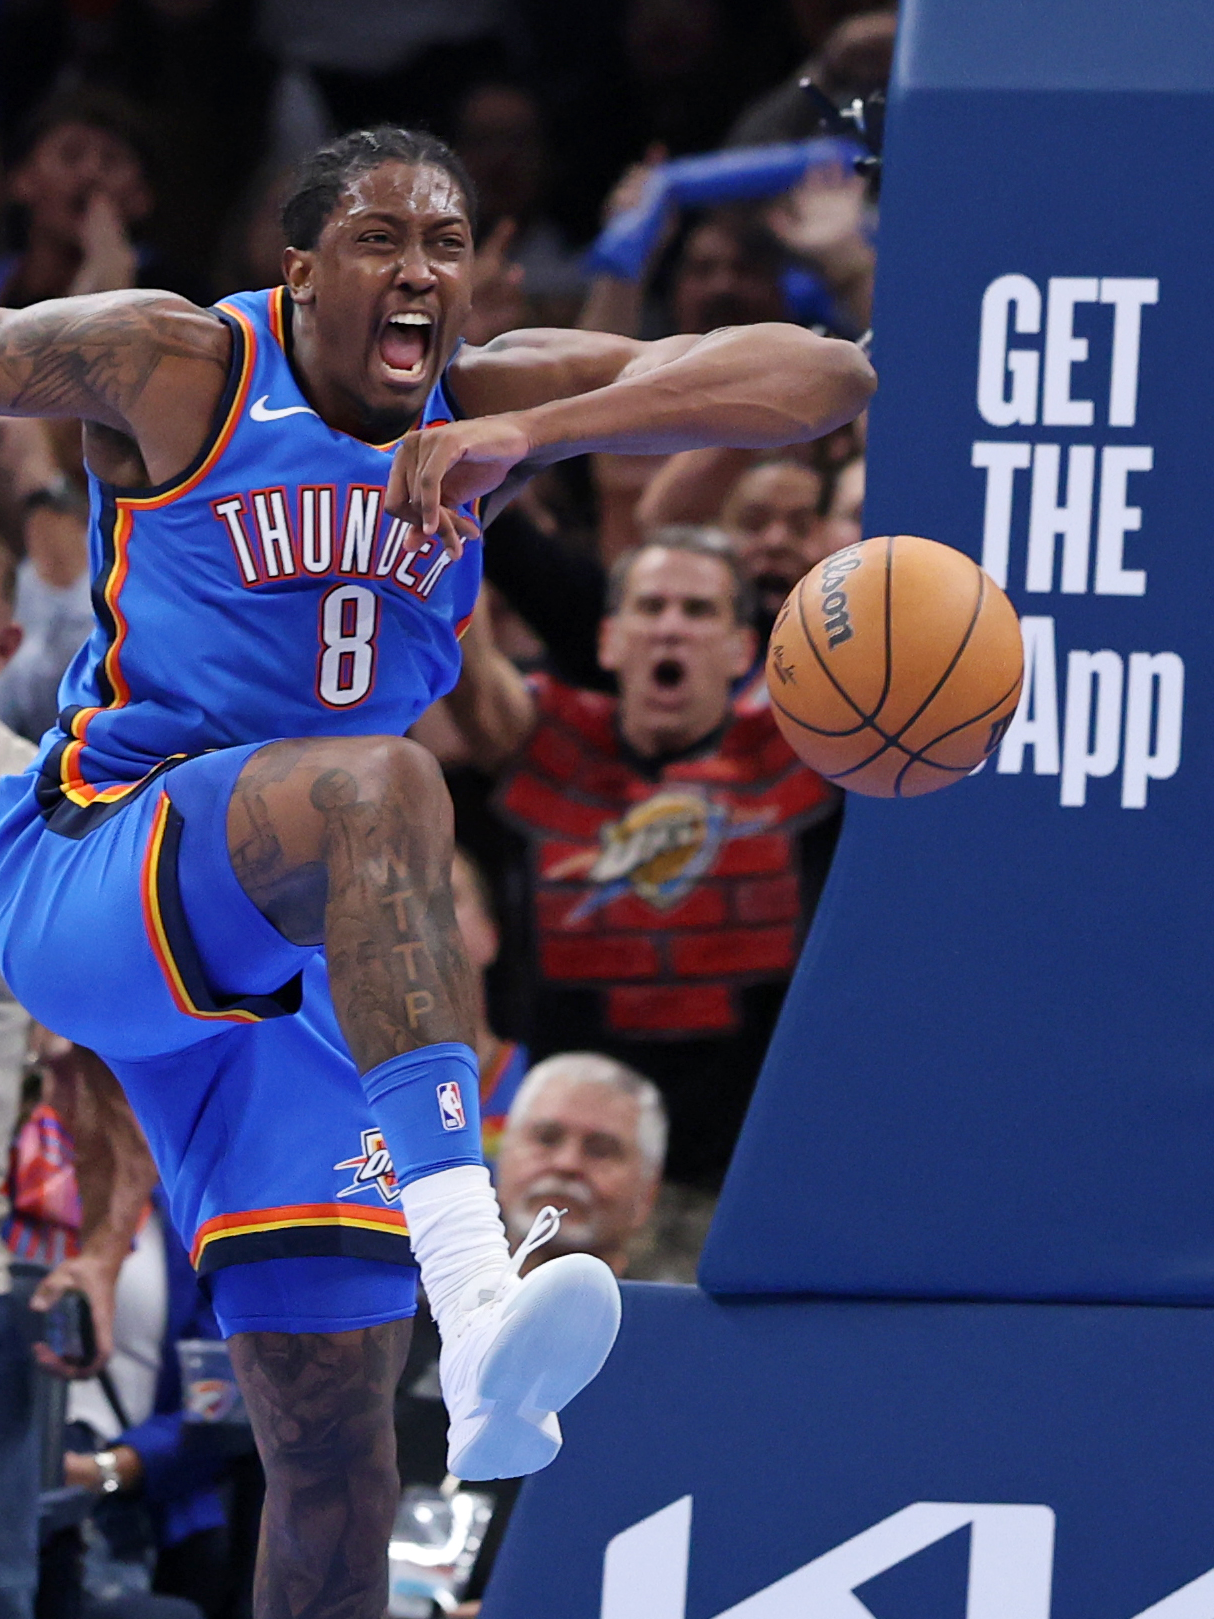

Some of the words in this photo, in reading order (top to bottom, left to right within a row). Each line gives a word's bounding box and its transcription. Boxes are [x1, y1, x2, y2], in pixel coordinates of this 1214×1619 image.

[977, 273, 1160, 428] GET
[971, 441, 1154, 597] THE
[315, 582, 379, 709] 8
[997, 615, 1185, 810] App
